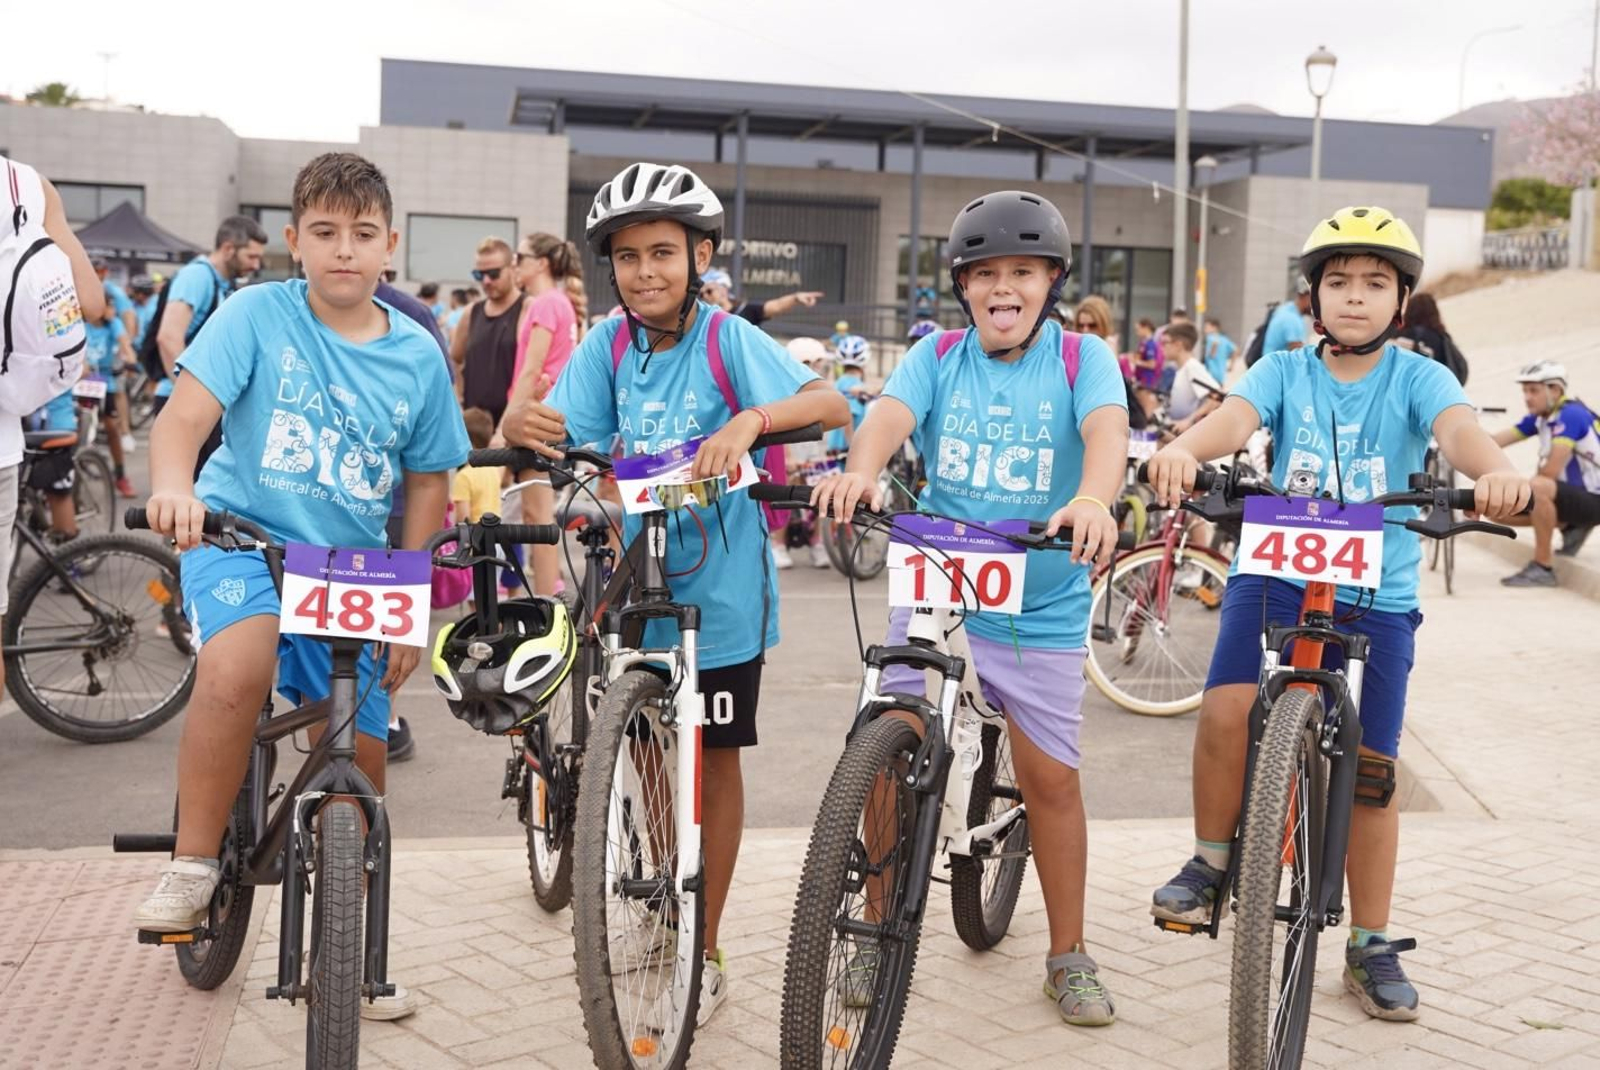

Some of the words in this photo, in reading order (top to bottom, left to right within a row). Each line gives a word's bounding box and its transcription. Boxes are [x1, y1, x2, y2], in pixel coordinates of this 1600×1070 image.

[278, 376, 324, 417] DÍA
[366, 424, 398, 448] LA
[674, 414, 701, 433] LA
[943, 413, 979, 437] DÍA
[987, 422, 1014, 441] DE
[1022, 424, 1052, 442] LA
[937, 435, 1054, 492] BICI
[259, 473, 310, 496] Huércal
[311, 486, 328, 500] de
[936, 480, 968, 497] Huércal
[969, 489, 982, 500] de
[983, 491, 1021, 504] Almería
[1023, 494, 1049, 505] 2025
[1275, 514, 1313, 522] DIPUTACIÓN
[1323, 518, 1349, 526] ALMERÍA
[922, 534, 959, 542] DIPUTACIÓN
[1251, 531, 1369, 580] 484
[904, 554, 1012, 607] 110
[294, 586, 414, 637] 483
